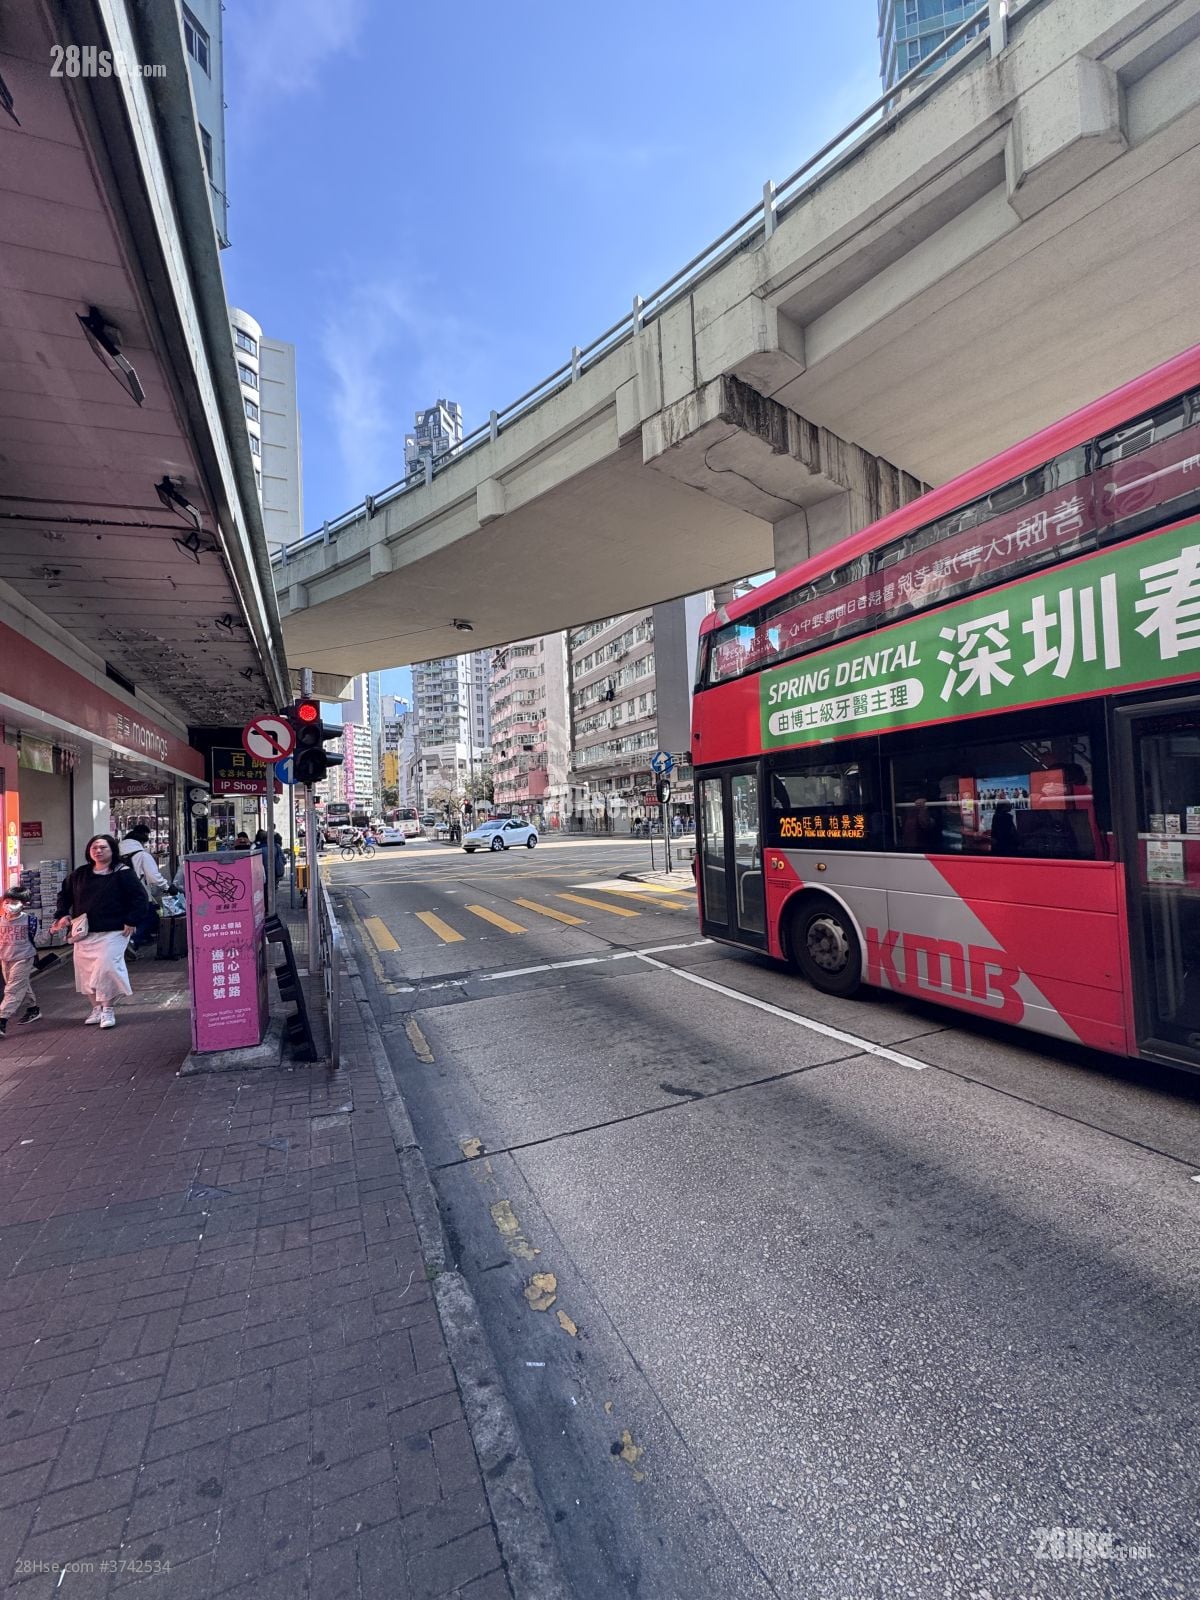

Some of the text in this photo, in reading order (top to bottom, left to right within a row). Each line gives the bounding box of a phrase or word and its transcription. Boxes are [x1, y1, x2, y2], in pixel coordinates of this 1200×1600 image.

[768, 640, 922, 706] SPRING DENTAL
[777, 684, 909, 732] 由博士級牙醫主理
[221, 781, 231, 790] IP
[233, 782, 258, 792] Shop
[780, 817, 803, 838] 265B
[803, 815, 823, 830] 旺角
[0, 925, 26, 934] UPER
[227, 948, 241, 998] 小心過路
[866, 927, 1025, 1024] KMB
